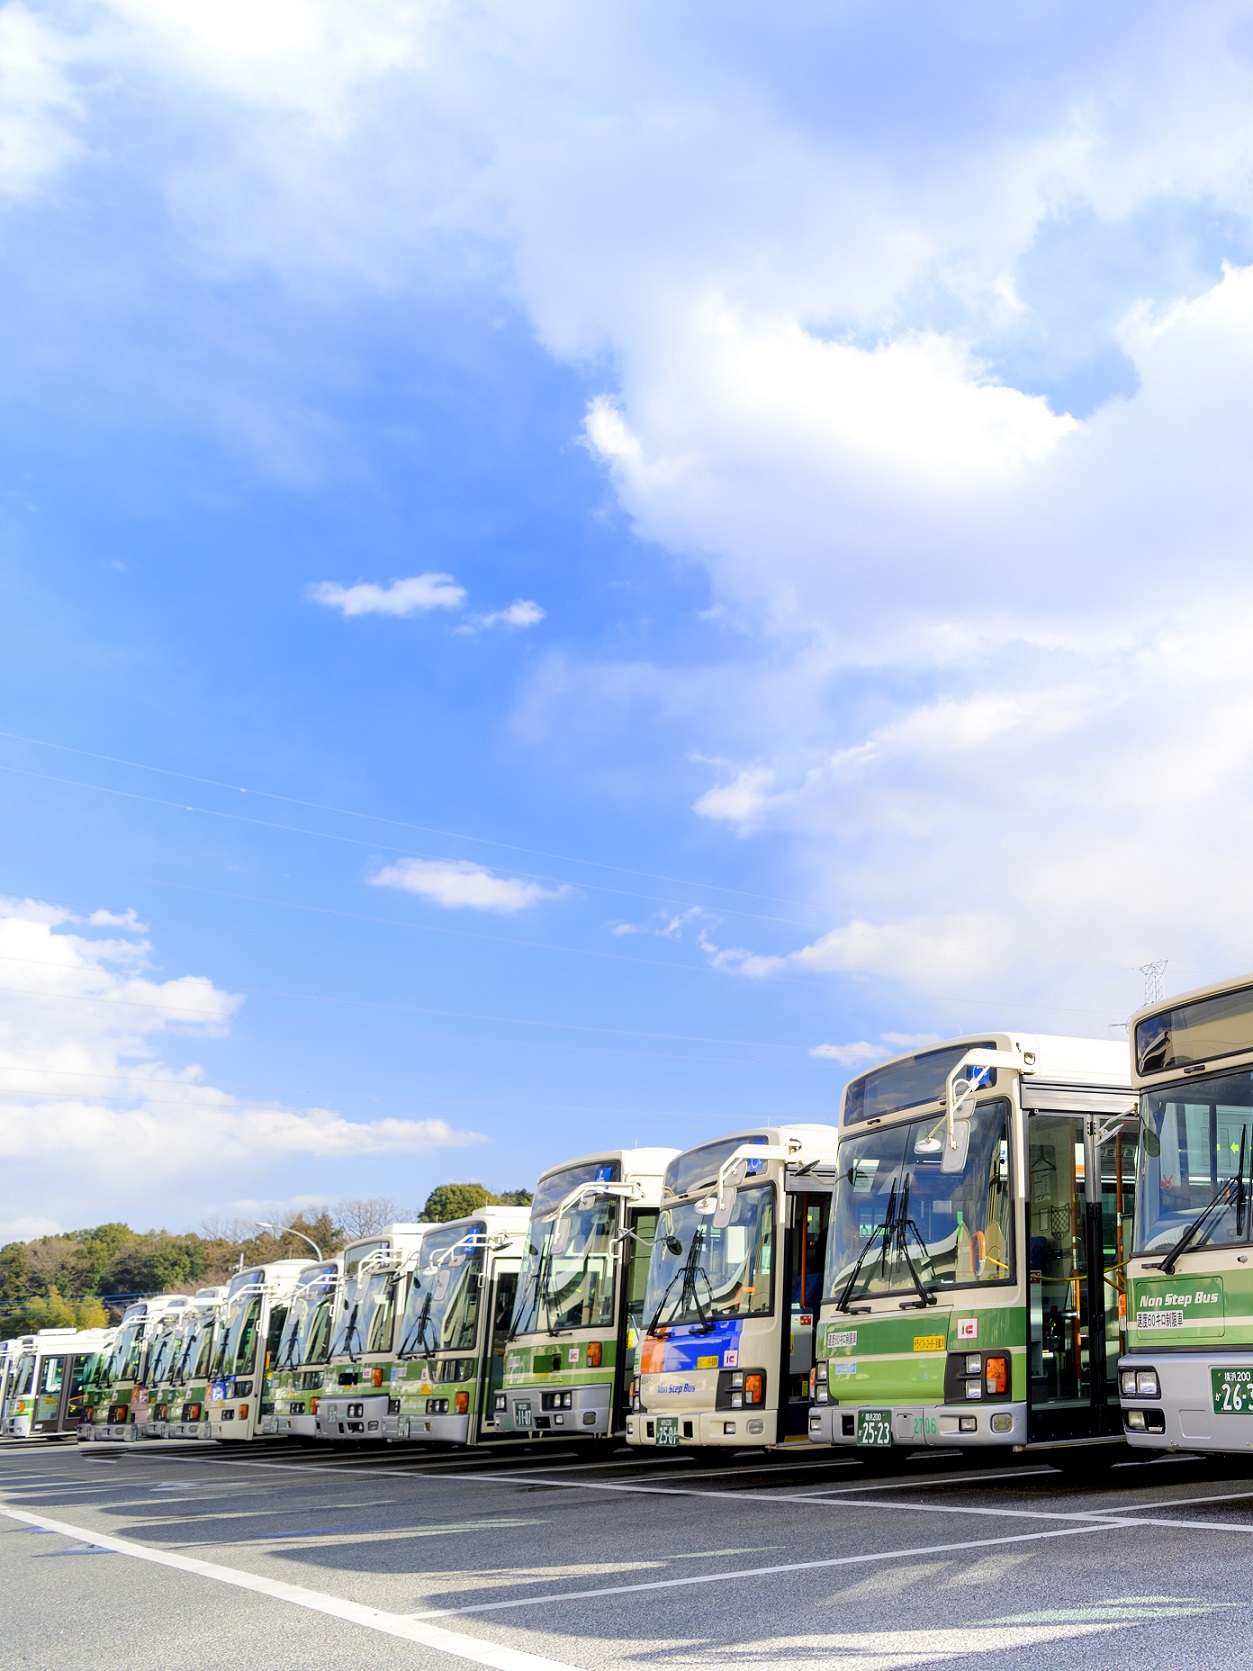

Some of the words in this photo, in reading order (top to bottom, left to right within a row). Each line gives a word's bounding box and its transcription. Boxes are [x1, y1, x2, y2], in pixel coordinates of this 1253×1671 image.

[1139, 1295, 1163, 1307] Non
[1164, 1293, 1193, 1307] Step
[1194, 1291, 1219, 1304] Bus
[1224, 1372, 1251, 1382] 横浜200
[683, 1383, 696, 1393] Bus
[862, 1422, 890, 1444] 25-23
[913, 1418, 937, 1435] 2706
